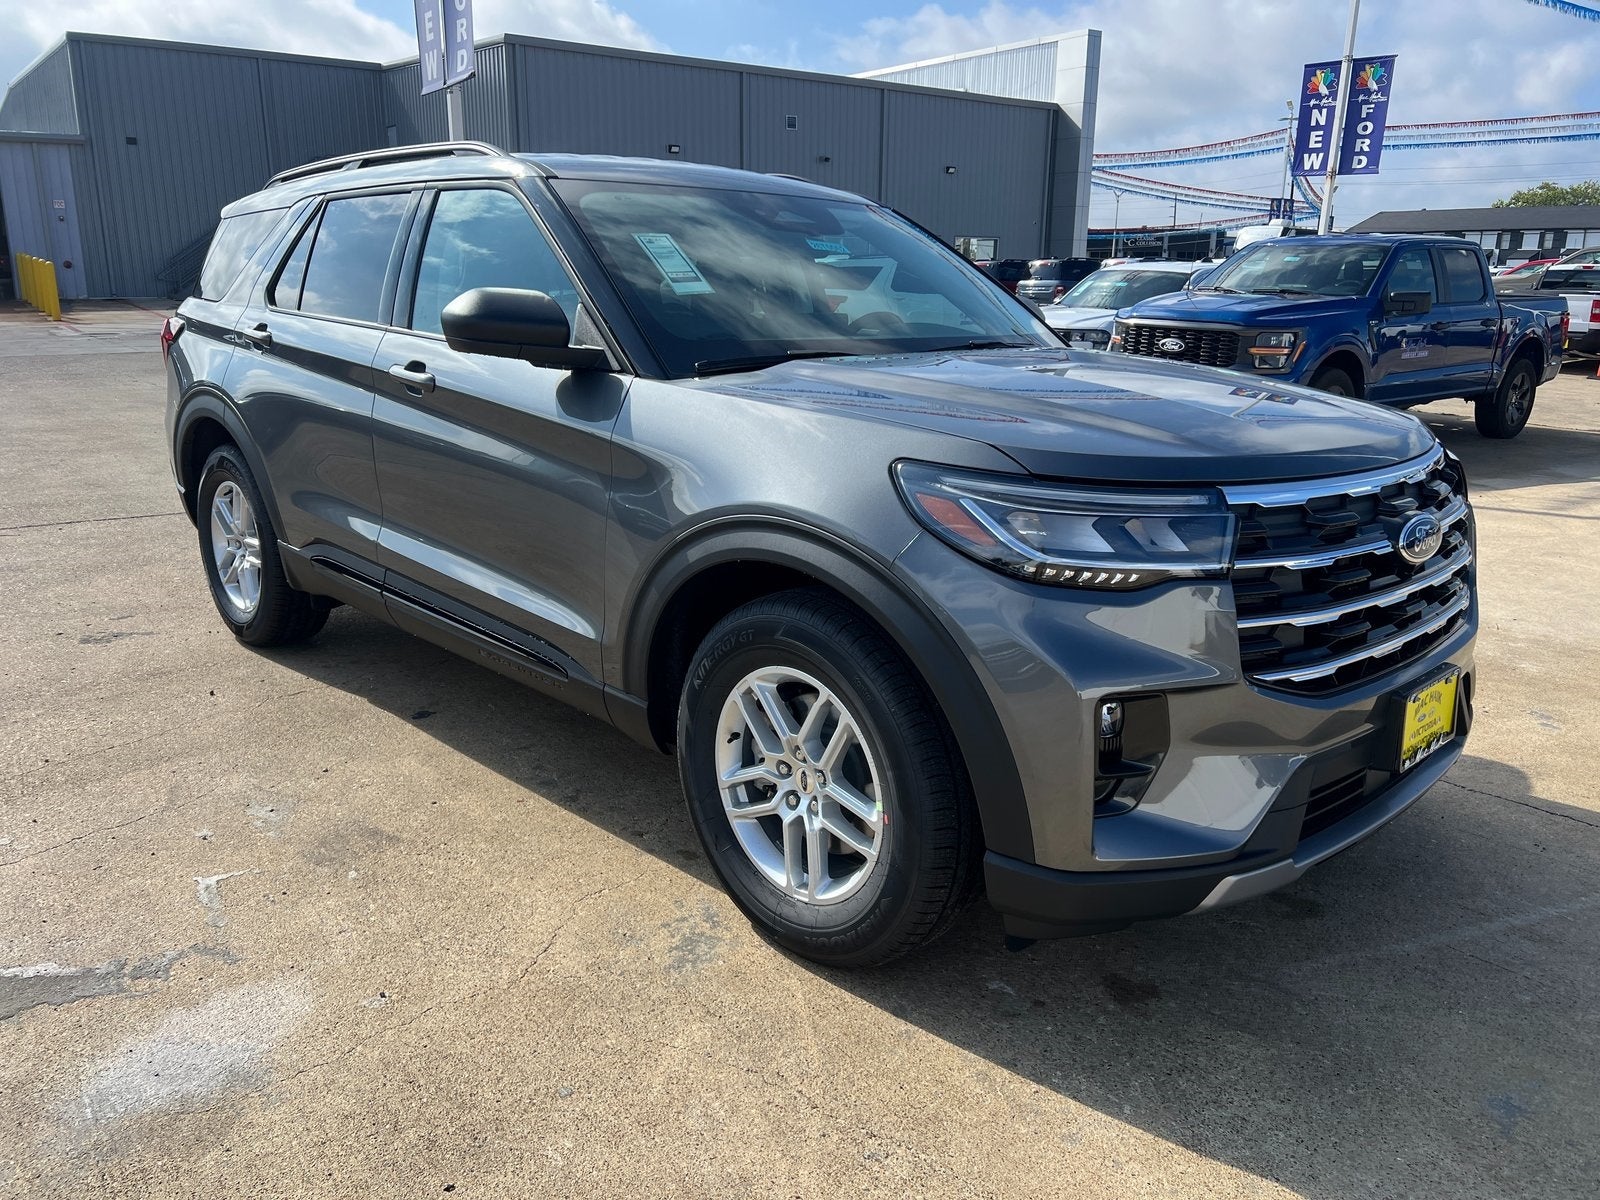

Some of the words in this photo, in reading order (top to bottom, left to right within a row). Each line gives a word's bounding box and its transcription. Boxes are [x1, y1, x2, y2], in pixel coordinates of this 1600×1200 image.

[423, 0, 437, 81] EW
[1303, 108, 1328, 171] NEW
[1351, 104, 1376, 169] FORD
[1411, 524, 1437, 553] Ford
